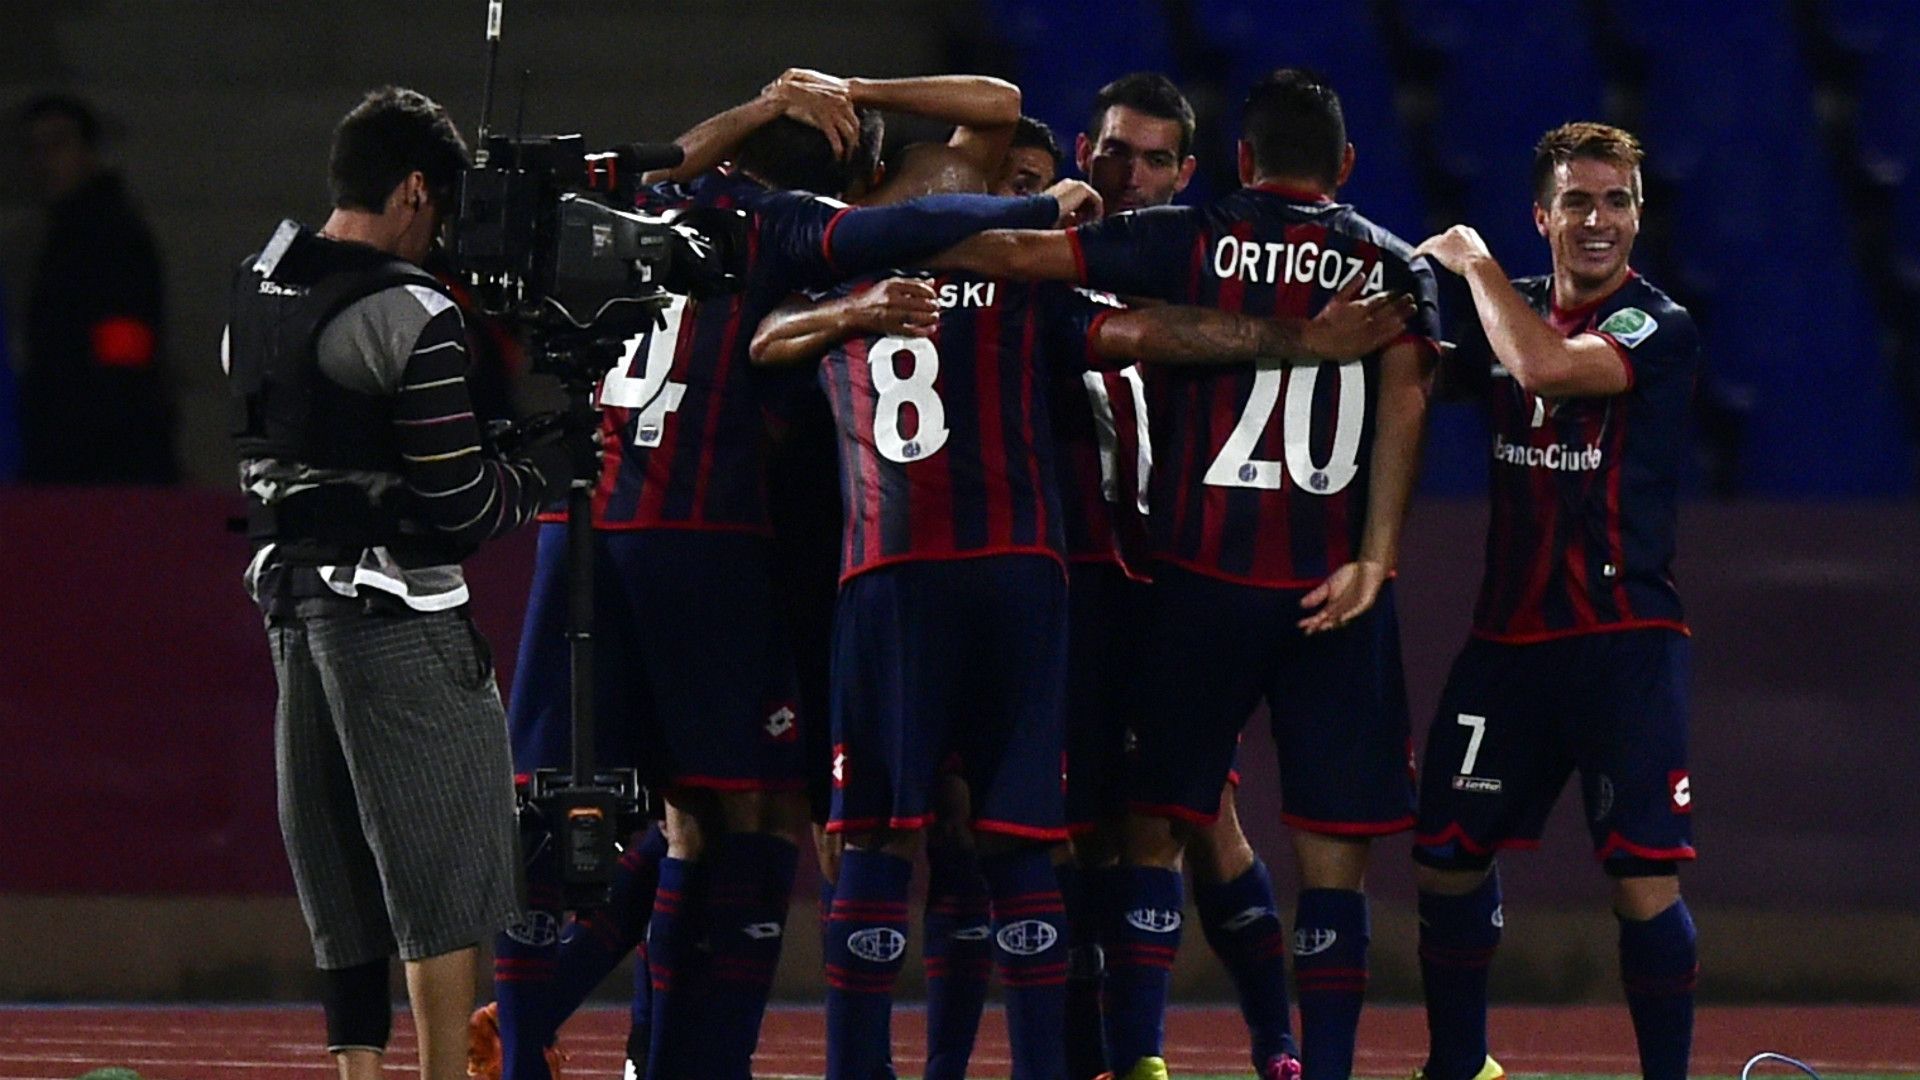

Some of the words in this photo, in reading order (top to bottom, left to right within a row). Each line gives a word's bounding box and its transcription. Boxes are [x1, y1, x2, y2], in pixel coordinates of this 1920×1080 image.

[937, 281, 996, 309] SKI
[1214, 235, 1384, 296] ORTIGOZA
[867, 334, 950, 463] 8
[1202, 357, 1365, 495] 20
[1457, 713, 1486, 775] 7
